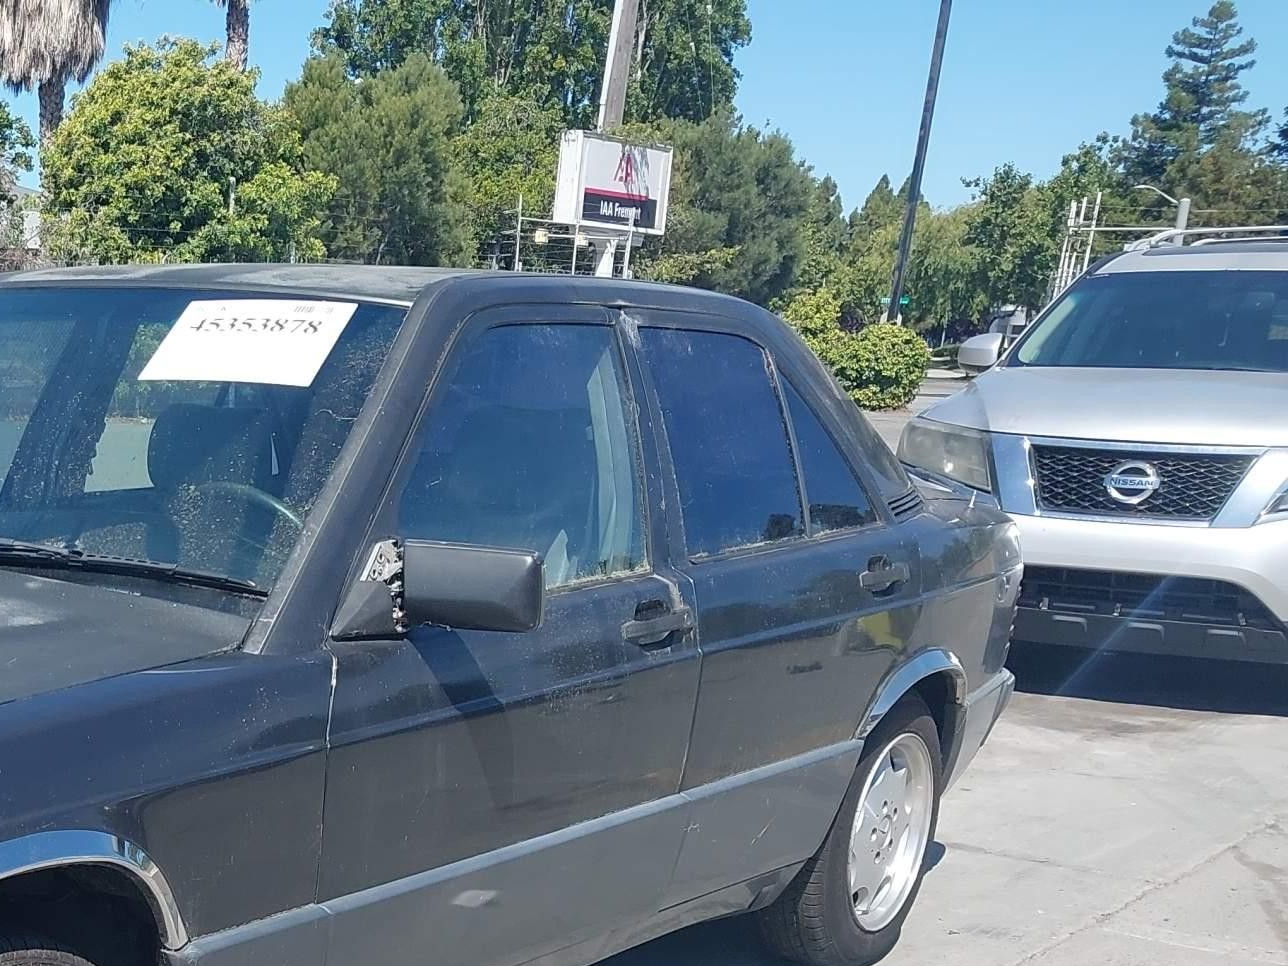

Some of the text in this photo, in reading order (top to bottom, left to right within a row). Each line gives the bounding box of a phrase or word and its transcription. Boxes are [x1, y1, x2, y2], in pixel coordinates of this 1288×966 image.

[600, 199, 613, 217] IAA
[190, 317, 323, 334] 45353878
[1110, 478, 1153, 487] NISSAN
